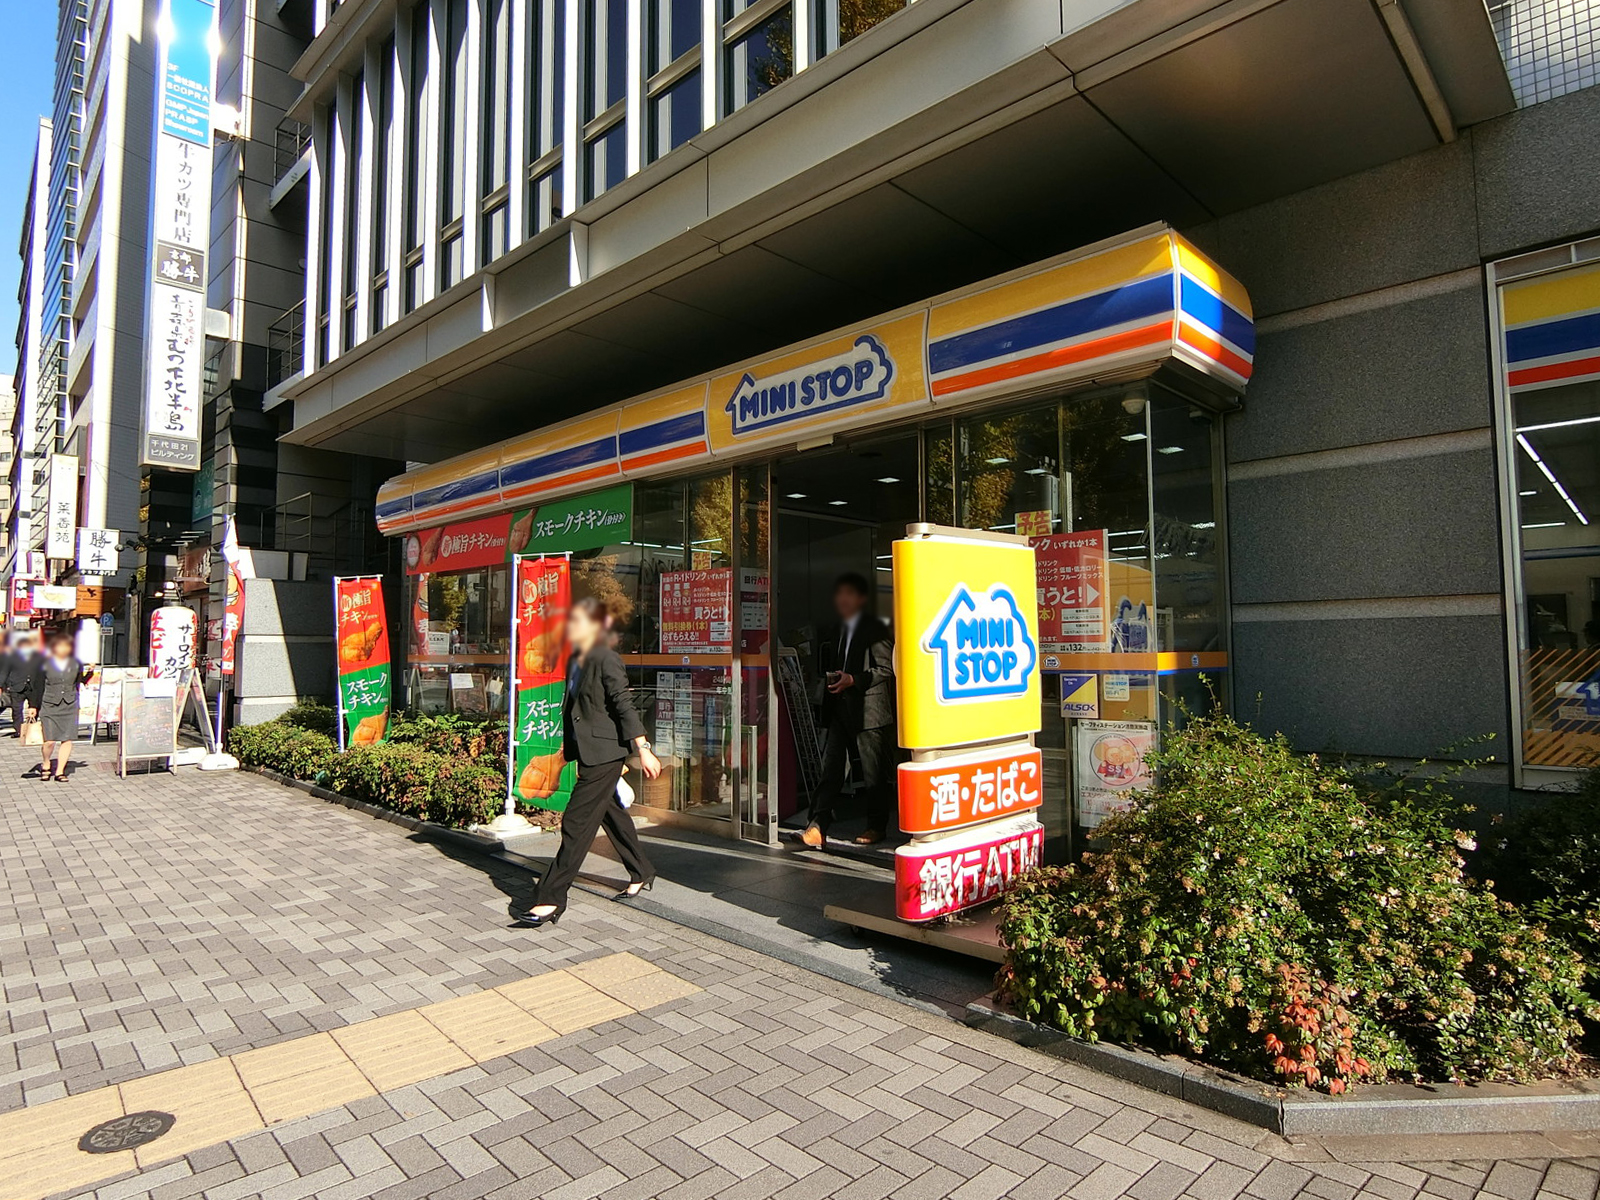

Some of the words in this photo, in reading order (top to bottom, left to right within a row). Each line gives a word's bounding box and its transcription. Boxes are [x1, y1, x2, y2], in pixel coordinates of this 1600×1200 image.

[174, 142, 193, 244] 牛カツ専門店
[739, 380, 797, 423] MINI
[800, 359, 875, 406] STOP
[151, 439, 189, 451] 千代田21
[151, 448, 195, 461] ビルディング
[1017, 511, 1050, 536] 予告
[90, 530, 113, 568] 勝牛
[1053, 538, 1098, 549] いずれか1本
[149, 610, 166, 680] 生ビール
[178, 623, 193, 672] サーロイン
[954, 617, 1014, 652] MINI
[346, 671, 388, 696] スモーク
[954, 650, 1018, 687] STOP
[347, 691, 383, 711] チキン
[1063, 703, 1096, 712] ALSOK
[521, 719, 561, 744] チキン
[929, 760, 1039, 825] 酒・たばこ
[918, 832, 1041, 915] 銀行ATM
